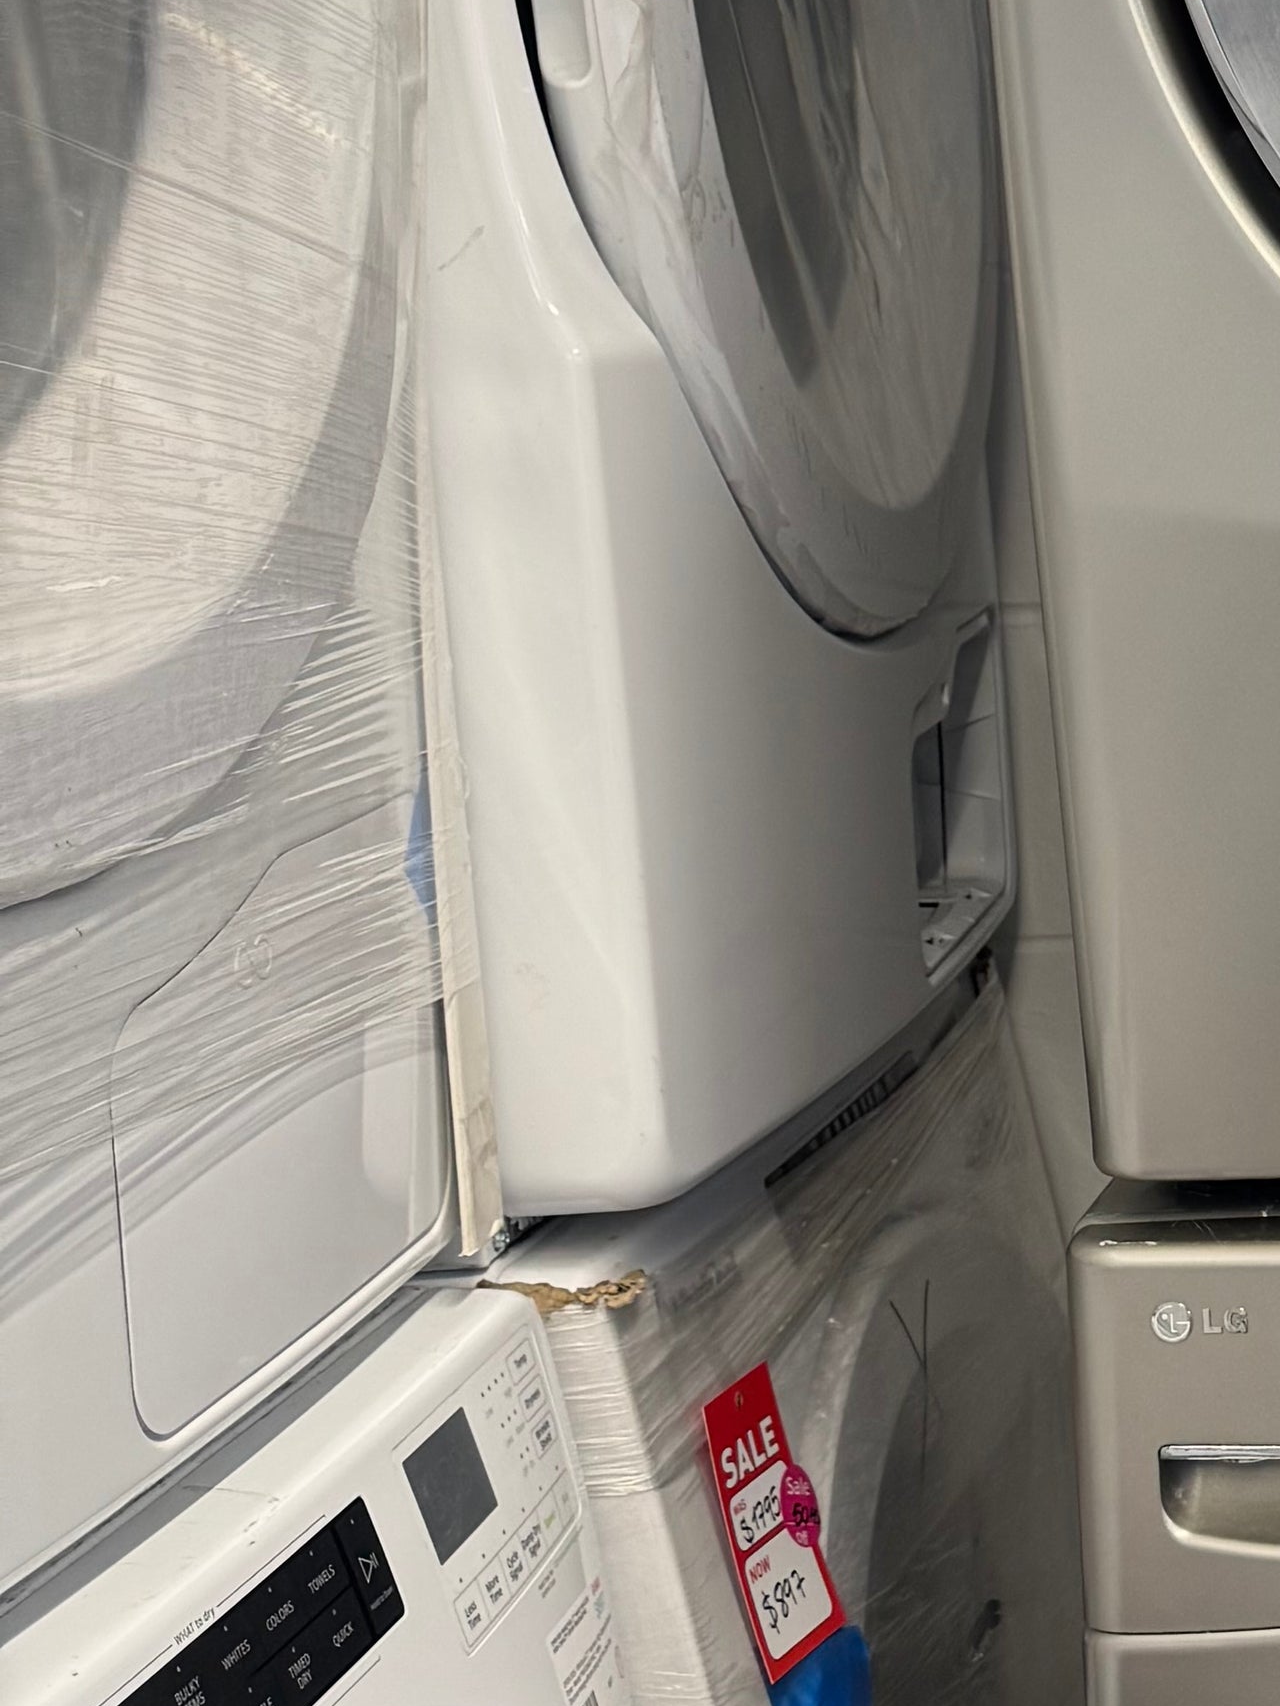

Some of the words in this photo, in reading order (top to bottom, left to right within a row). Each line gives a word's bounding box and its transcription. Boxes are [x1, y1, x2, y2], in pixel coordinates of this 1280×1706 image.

[1203, 1307, 1248, 1334] LG
[722, 1415, 779, 1489] SALE
[308, 1565, 335, 1594] TOWELS
[750, 1556, 771, 1583] NOW
[266, 1600, 295, 1631] COLORS
[762, 1570, 806, 1634] $897
[332, 1622, 354, 1647] QUICK
[221, 1639, 251, 1670] WHITES
[288, 1653, 311, 1679] TIMED
[174, 1676, 200, 1706] BULKY
[297, 1671, 313, 1690] DRY
